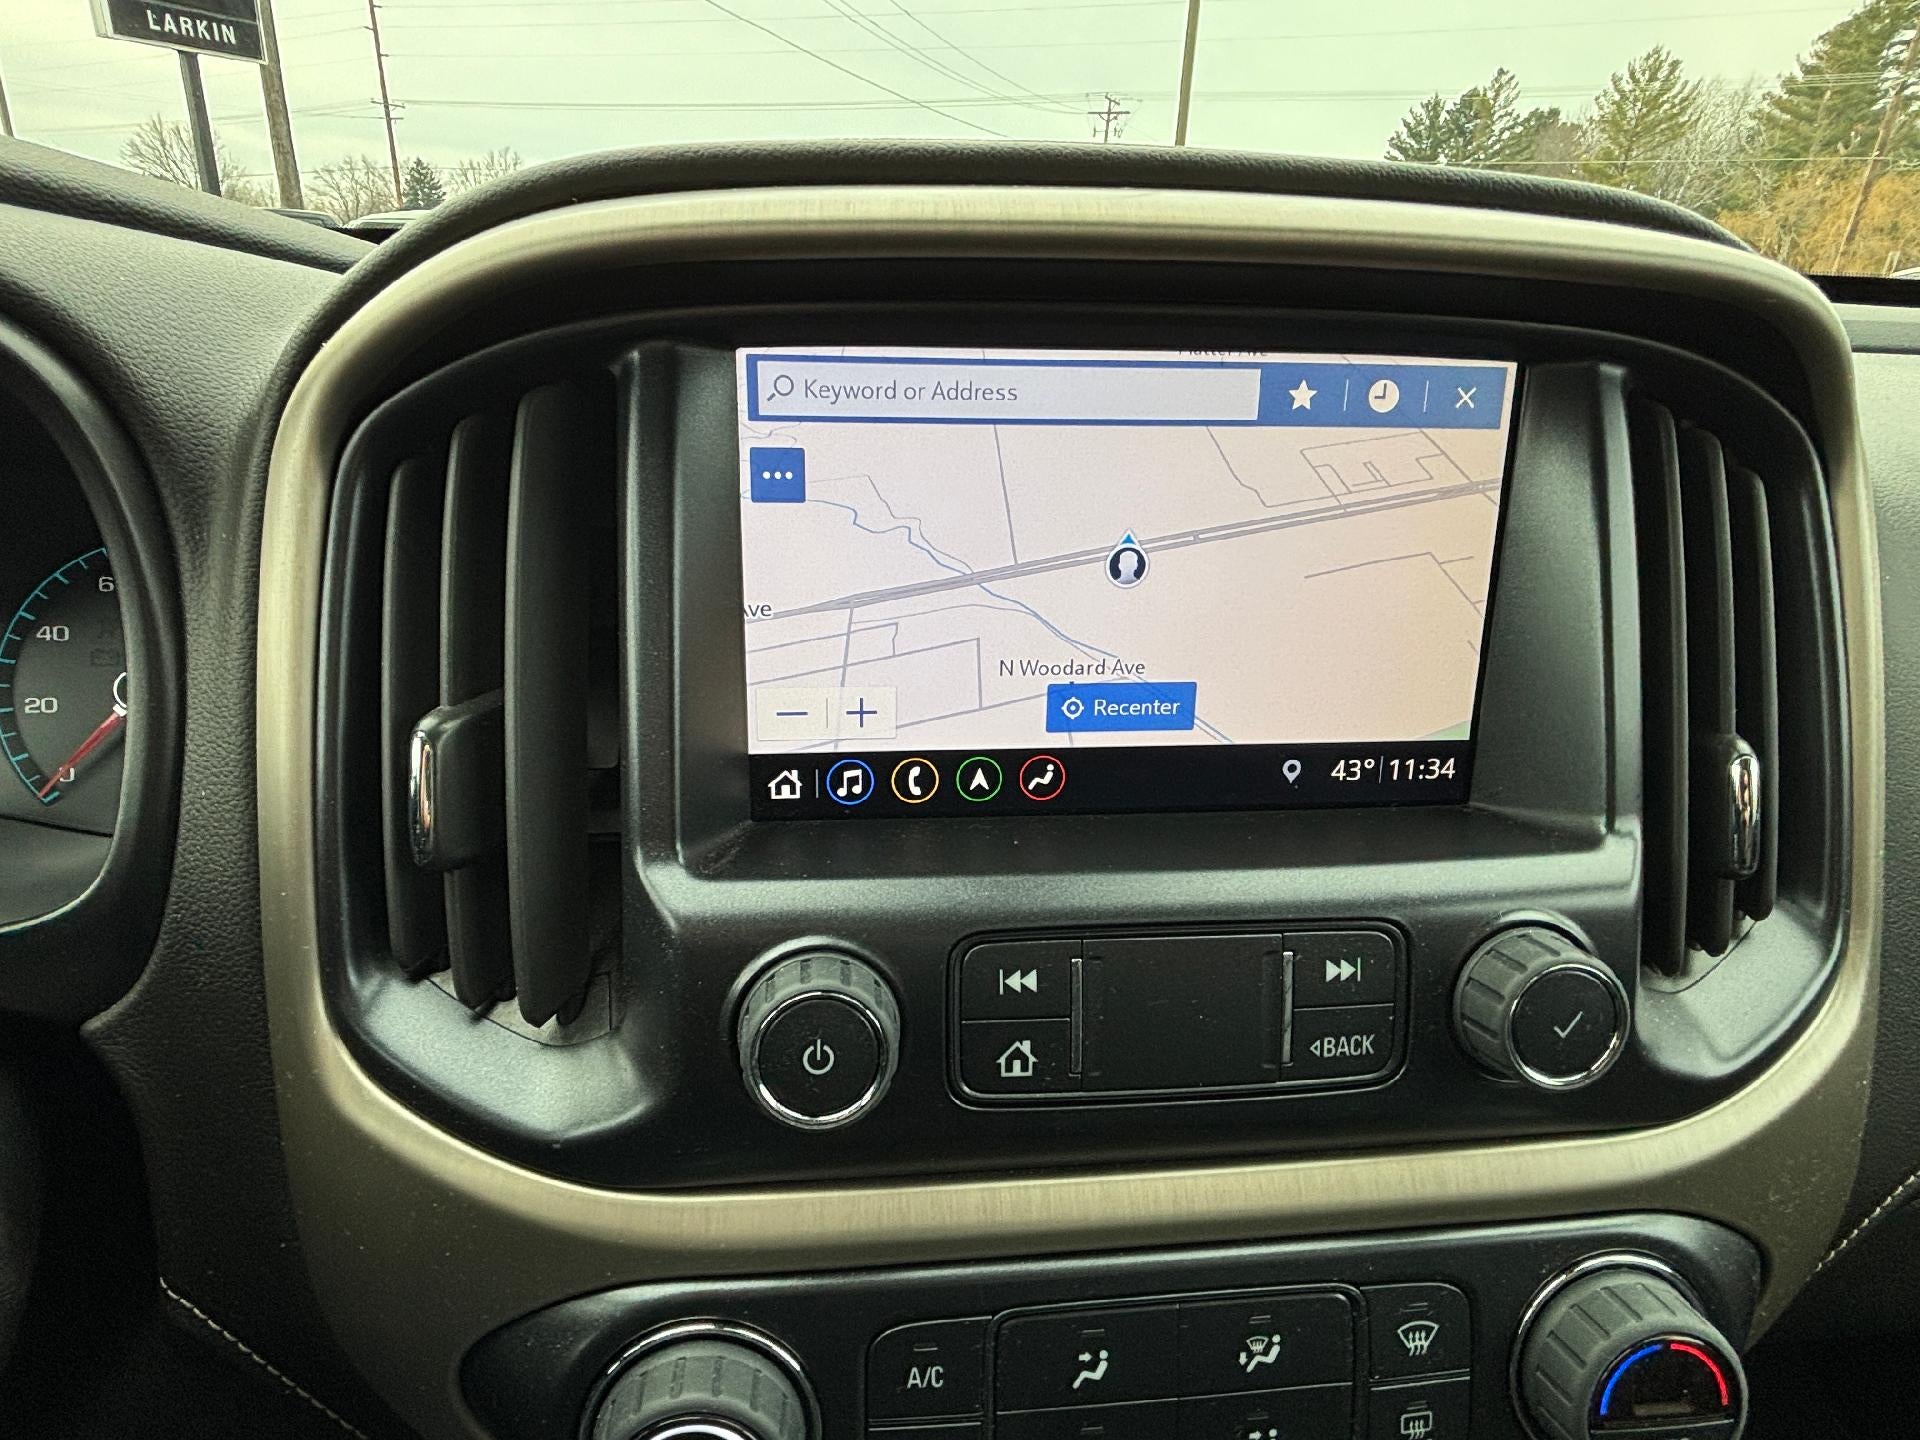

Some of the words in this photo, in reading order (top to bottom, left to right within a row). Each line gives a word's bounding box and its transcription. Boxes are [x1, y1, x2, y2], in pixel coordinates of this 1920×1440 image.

[146, 9, 237, 45] LARKIN
[804, 378, 896, 404] Keyword
[903, 384, 926, 401] or
[931, 380, 1018, 401] Address
[36, 625, 70, 642] 40
[999, 659, 1013, 676] N
[1019, 659, 1105, 676] Woodard
[1110, 659, 1146, 676] Ave
[24, 697, 58, 714] 20
[1094, 700, 1180, 717] Recenter
[1330, 758, 1375, 781] 43°
[1389, 757, 1456, 781] 11:34
[1323, 1035, 1375, 1058] BACK
[907, 1366, 944, 1388] A/C
